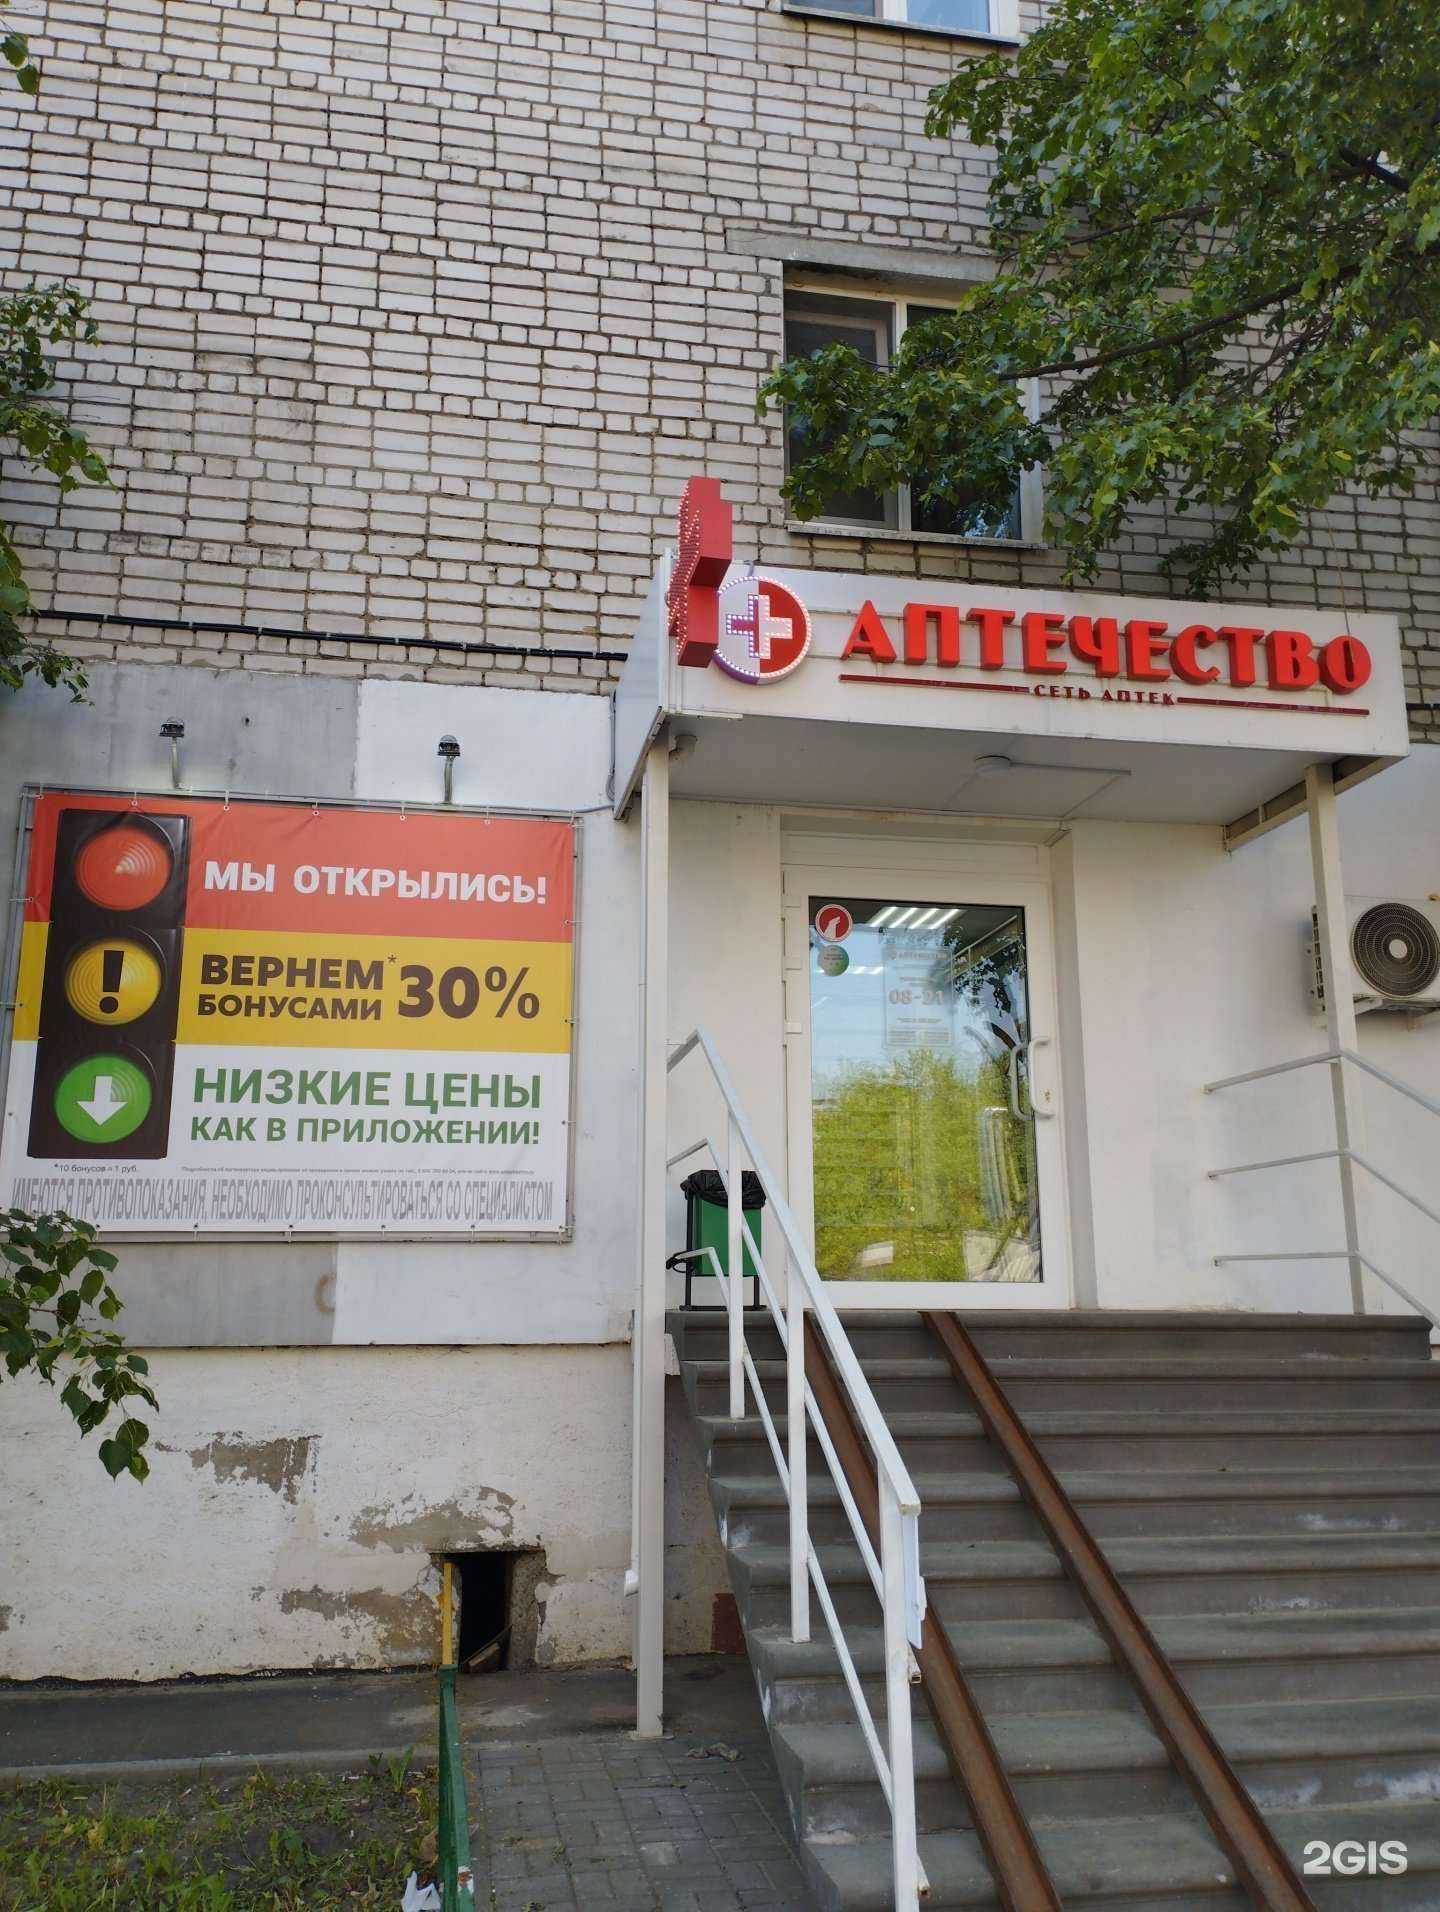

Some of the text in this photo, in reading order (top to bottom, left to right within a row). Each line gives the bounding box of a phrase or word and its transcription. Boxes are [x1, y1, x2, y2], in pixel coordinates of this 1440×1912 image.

[839, 600, 1372, 694] АПТЕЧЕСТВО
[1034, 684, 1175, 705] СЕТЬ АПТЕК
[204, 861, 546, 904] МЫ ОТКРЫЛИСЬ!
[197, 993, 382, 1021] БОНУСАМИ
[397, 964, 540, 1019] 30%
[193, 1067, 541, 1115] НИЗКИЕ ЦЕНЫ
[190, 1116, 540, 1145] КАК В ПРИЛОЖЕНИИ!
[71, 1164, 105, 1174] бонусов
[11, 1177, 75, 1217] ИМЕЮТСЯ
[210, 1178, 294, 1222] НЕОБХОДИМО
[295, 1179, 443, 1221] ПРОКОНСУЛЬТИРОВАТЬСЯ
[445, 1180, 462, 1221] СО
[464, 1180, 553, 1224] СПЕЦИАЛИСТОМ
